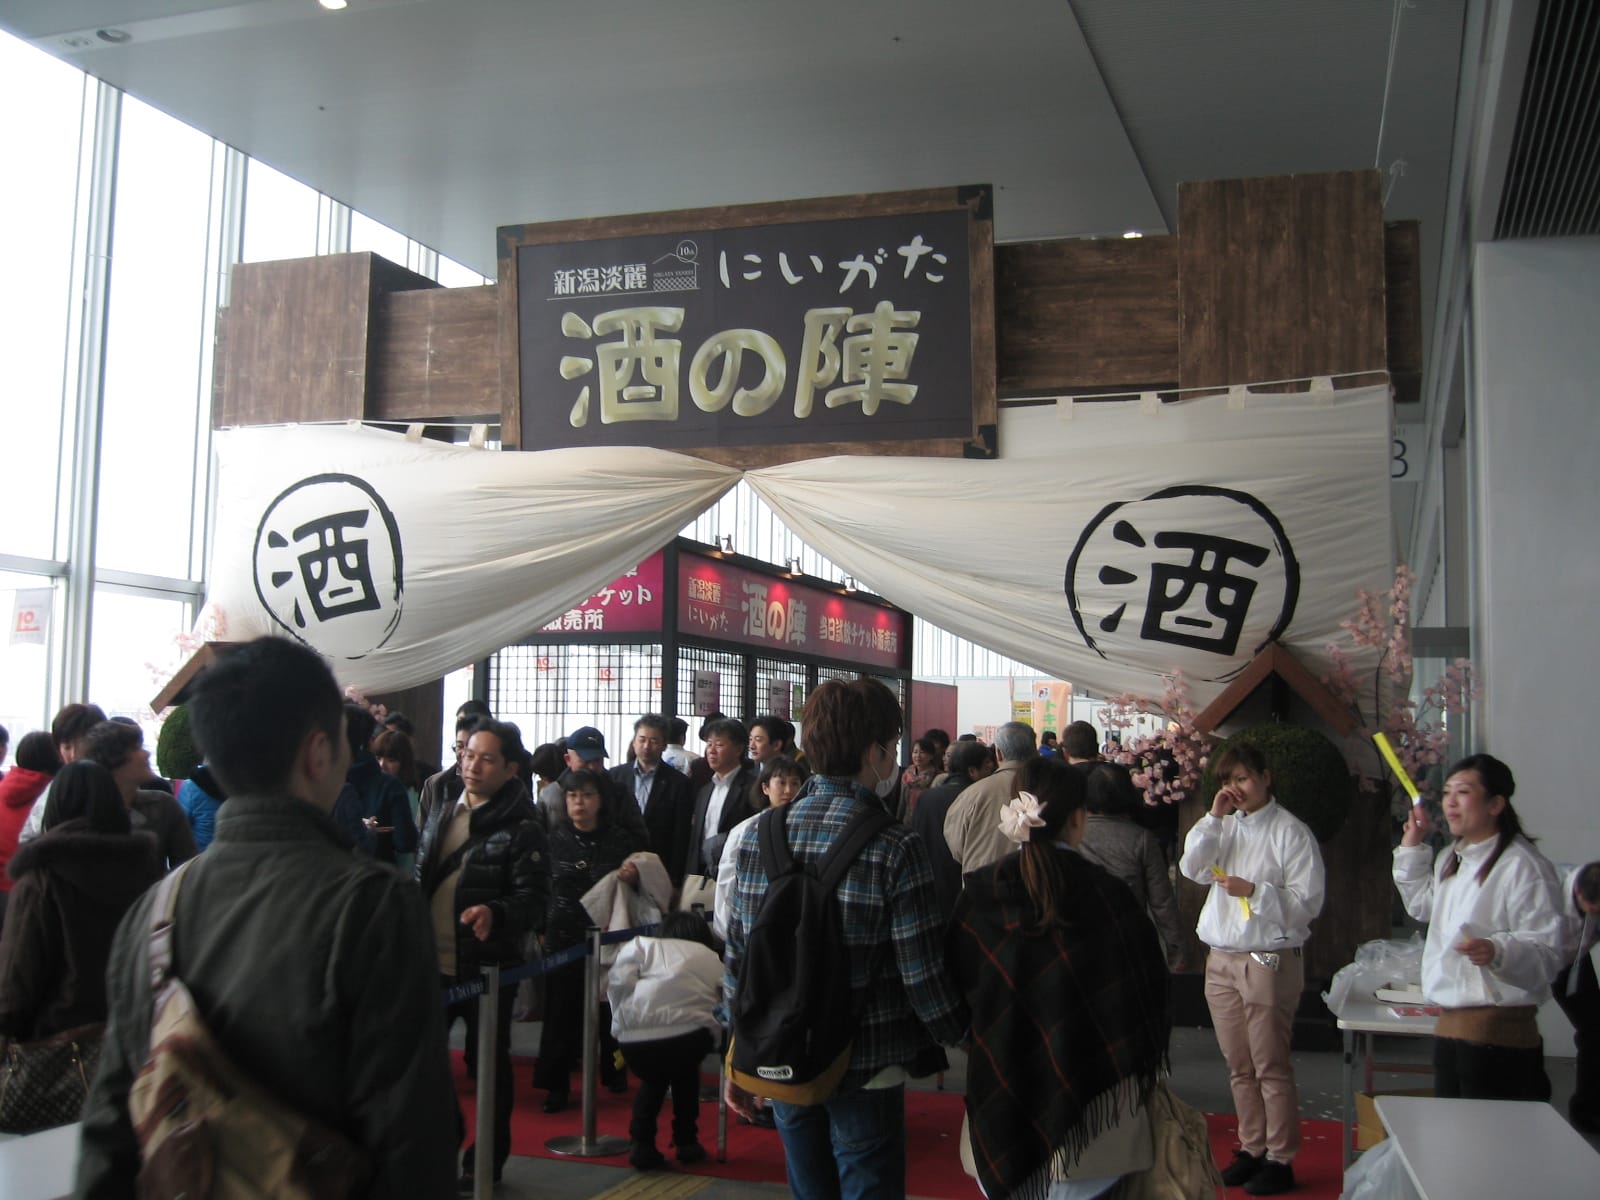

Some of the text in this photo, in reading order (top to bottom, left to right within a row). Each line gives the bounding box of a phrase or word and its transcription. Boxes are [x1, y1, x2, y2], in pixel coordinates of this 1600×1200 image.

[554, 263, 647, 295] 新潟淡麗
[718, 234, 948, 294] にいがた
[560, 300, 921, 428] 酒の陣
[268, 509, 381, 628] 酒
[581, 585, 652, 606] ケット
[1098, 520, 1271, 656] 酒
[688, 604, 728, 632] にいがた
[741, 580, 807, 646] 酒の陣
